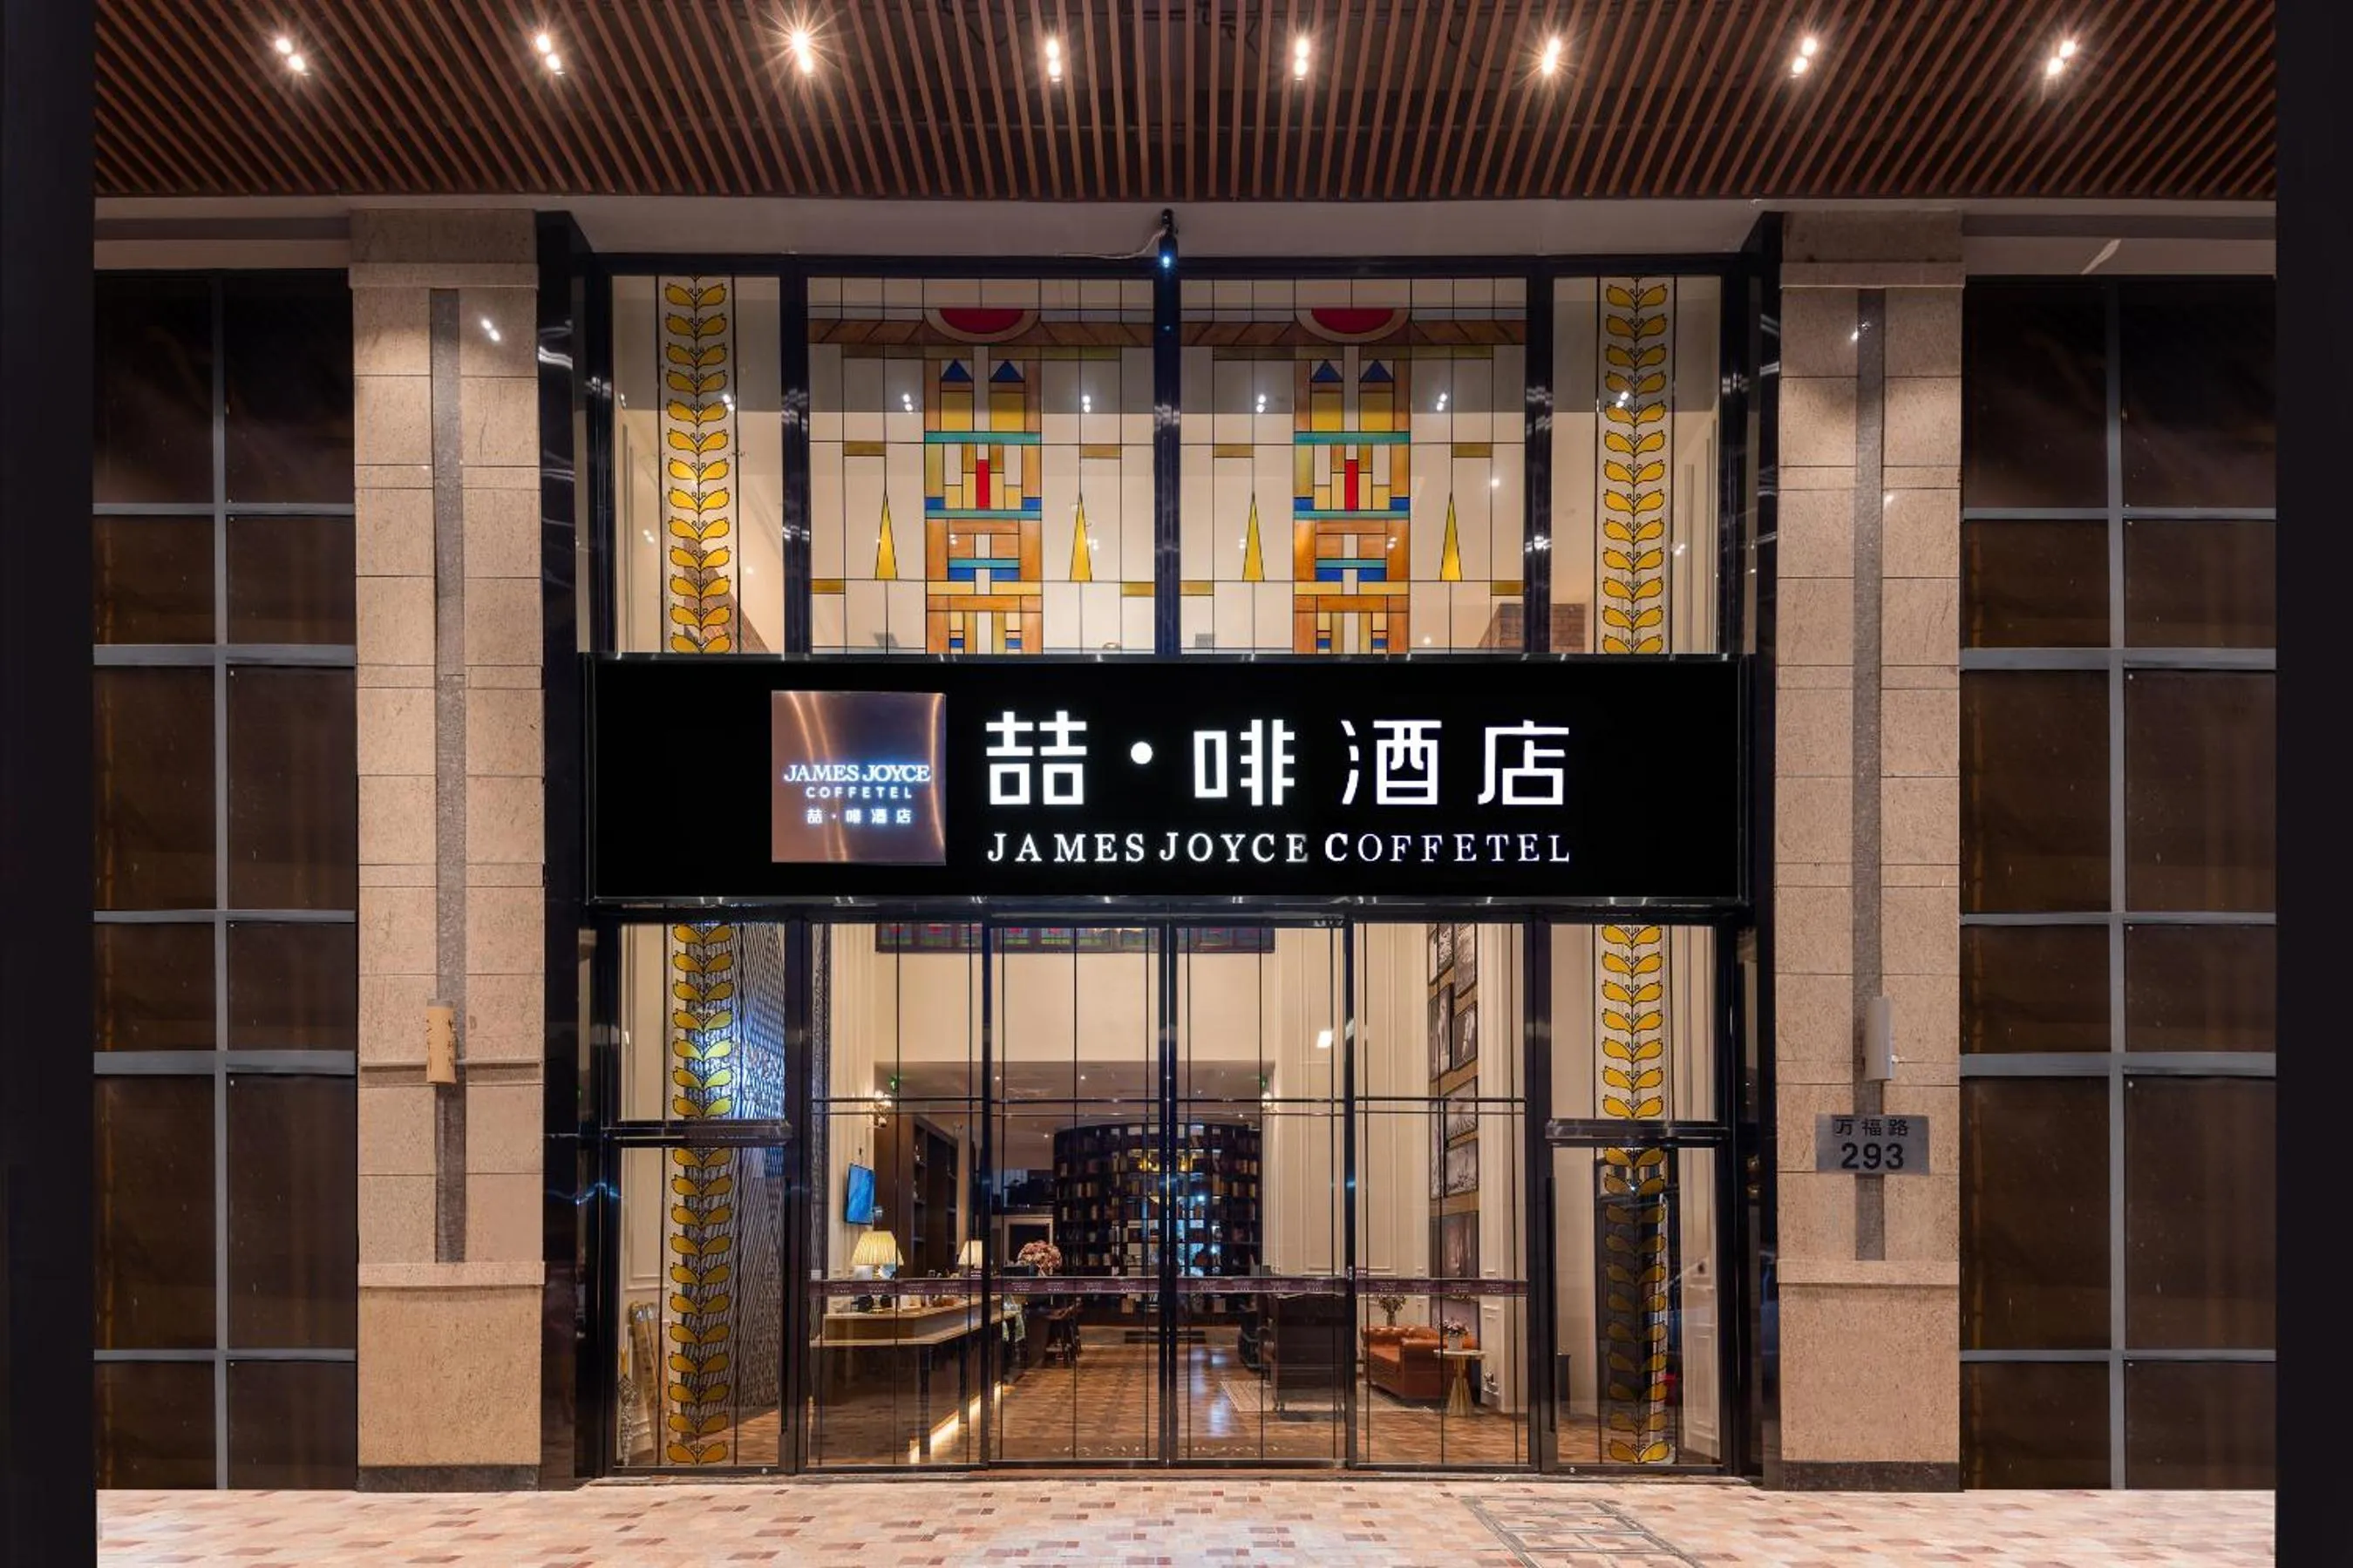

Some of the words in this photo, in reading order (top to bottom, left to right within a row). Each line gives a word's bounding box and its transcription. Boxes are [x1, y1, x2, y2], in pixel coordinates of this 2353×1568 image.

[784, 764, 860, 783] JAMES
[862, 764, 931, 783] JOYCE
[806, 785, 913, 799] COFFETEL
[987, 832, 1144, 862] JAMES
[1159, 832, 1308, 862] JOYCE
[1324, 832, 1570, 862] COFFETEL
[1834, 1118, 1909, 1137] 万福路
[1840, 1142, 1904, 1170] 293
